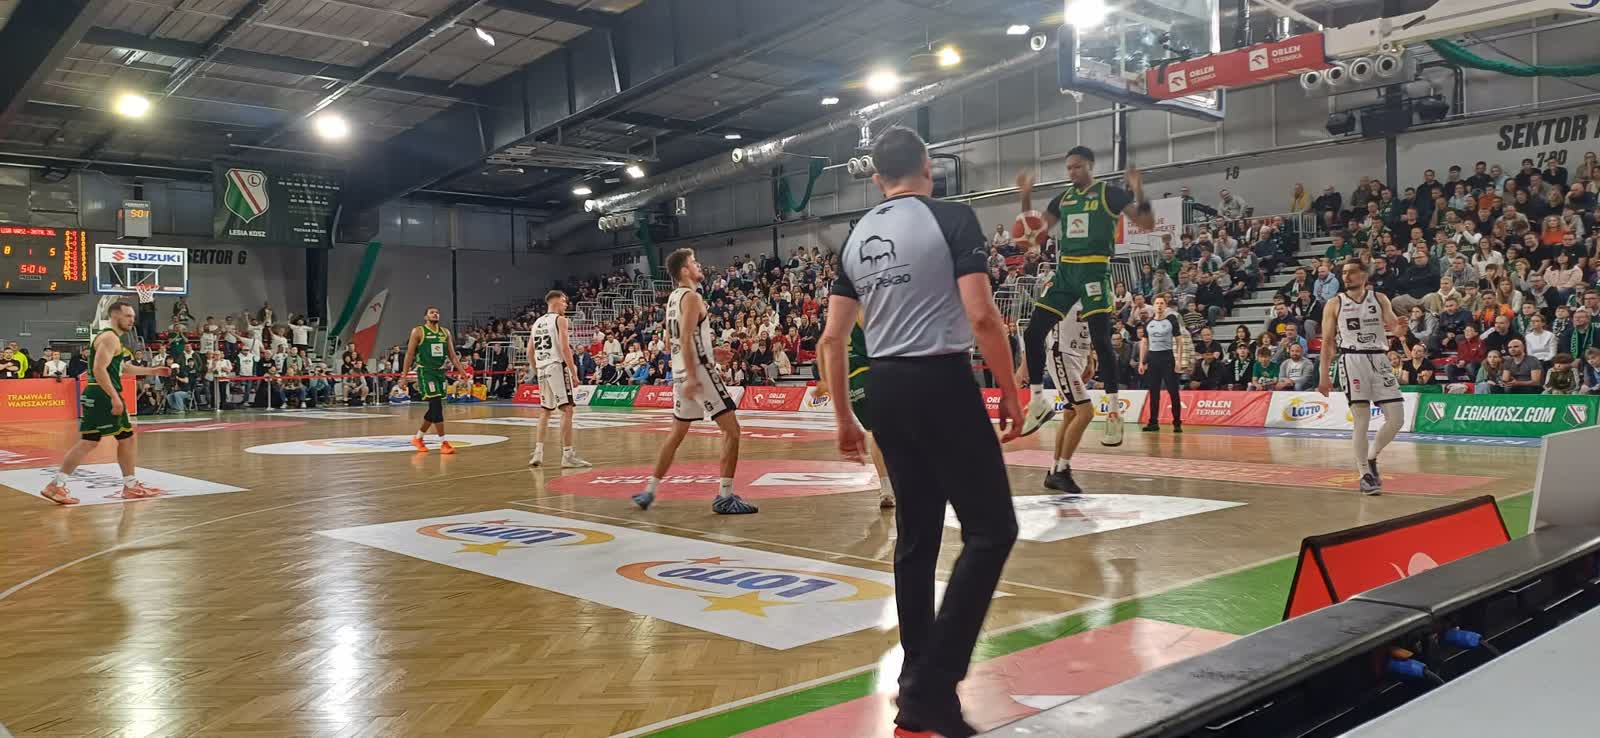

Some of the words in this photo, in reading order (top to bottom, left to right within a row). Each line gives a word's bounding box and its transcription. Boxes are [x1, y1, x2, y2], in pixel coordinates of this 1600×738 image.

[1272, 45, 1301, 58] ORLEN
[1189, 65, 1215, 78] ORLEN
[1497, 114, 1588, 151] SEKTOR
[1083, 200, 1099, 211] 10
[228, 228, 249, 237] LEGIA
[248, 229, 266, 238] KOSZ
[49, 247, 56, 257] 5
[127, 251, 181, 263] SUZUKI
[188, 249, 233, 265] SEKTOR
[237, 250, 249, 265] G
[1368, 305, 1377, 314] 3
[534, 335, 553, 351] 23
[7, 393, 53, 401] TRAMWAJE
[7, 399, 66, 408] WARSZAWSKIE
[1197, 400, 1232, 409] ORLEN
[1195, 408, 1232, 417] TERMIKA
[1291, 405, 1321, 418] LOTTO
[1454, 405, 1556, 423] LEGIAKOSZ.COM
[446, 526, 577, 545] LOTTO
[657, 567, 838, 598] LOTTO
